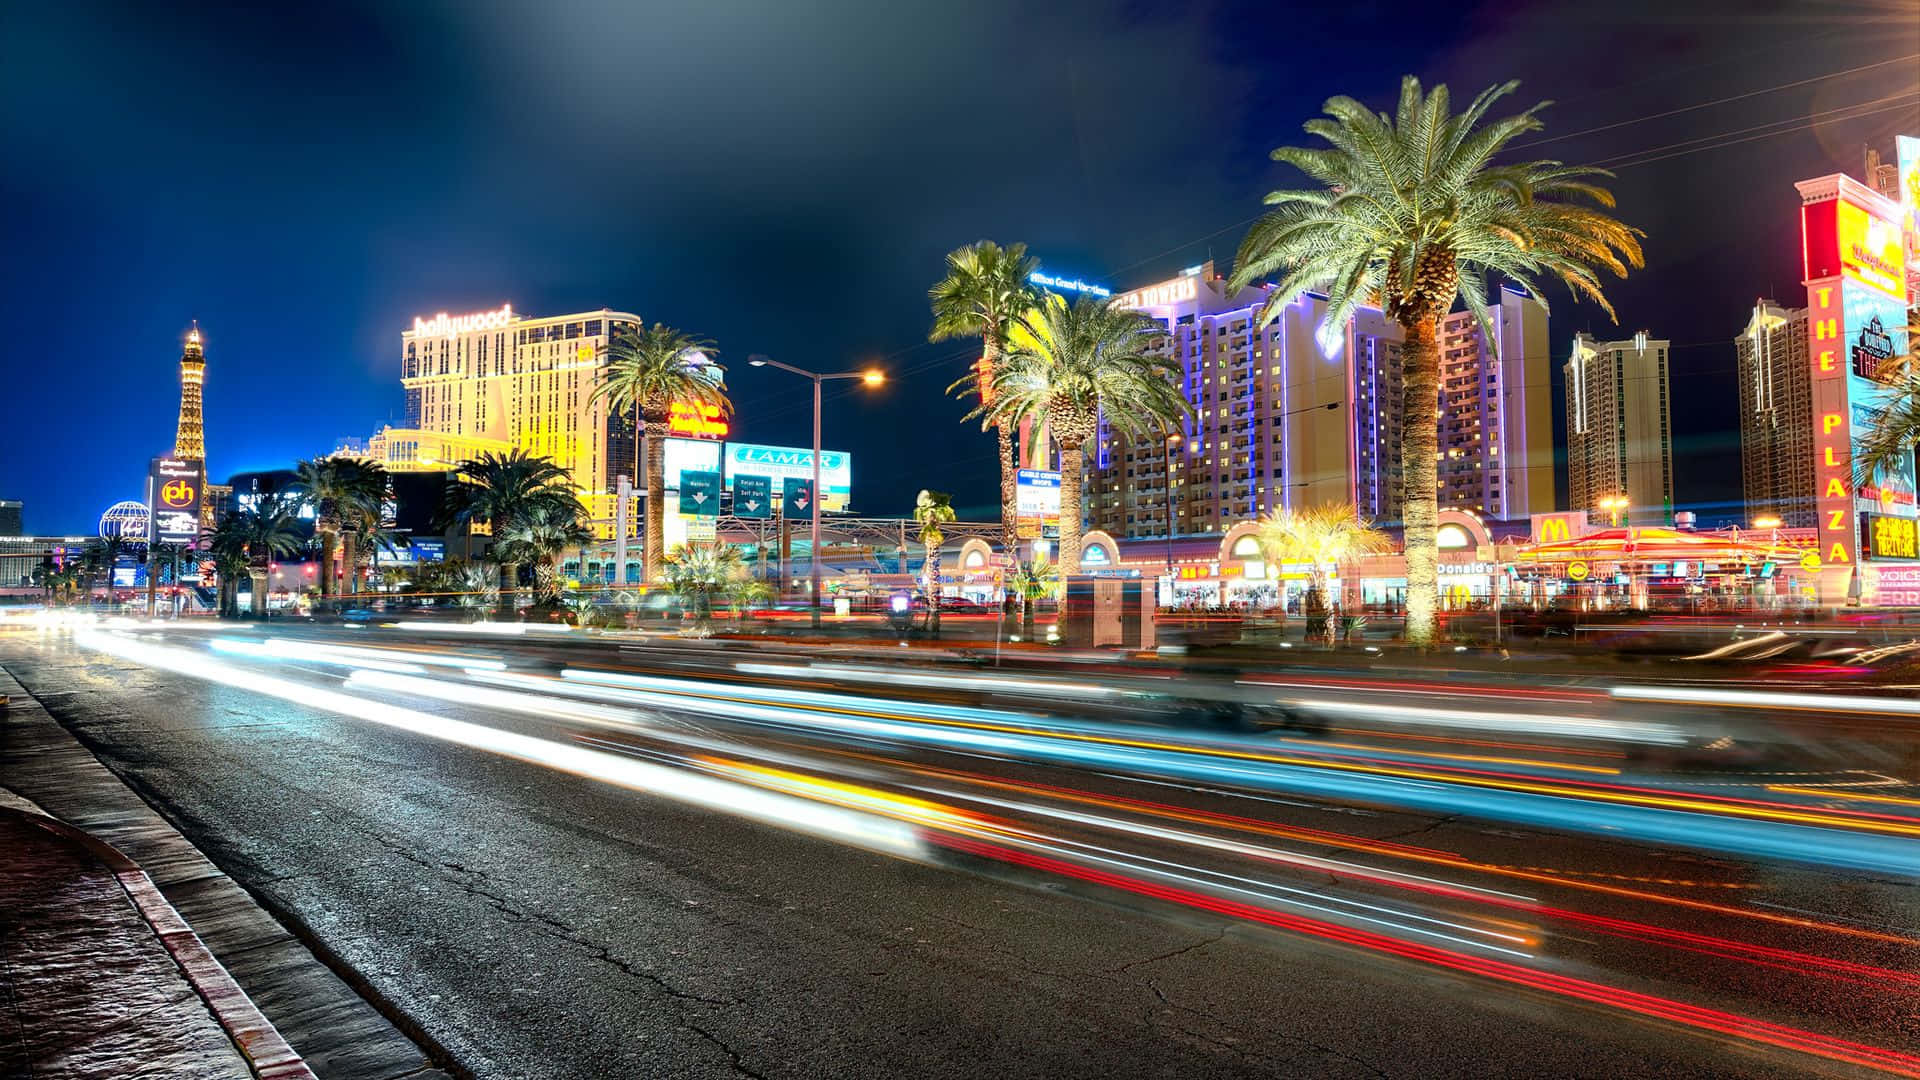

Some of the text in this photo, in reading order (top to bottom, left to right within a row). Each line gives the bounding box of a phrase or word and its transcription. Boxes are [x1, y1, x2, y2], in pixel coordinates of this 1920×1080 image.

[1030, 272, 1110, 297] Hilton Grand Vacations
[1142, 277, 1195, 305] TOWERS
[414, 303, 512, 341] hollywood
[1816, 287, 1849, 562] THE PLAZA
[744, 449, 832, 467] LAMAR
[164, 480, 193, 503] ph
[1437, 562, 1494, 574] Donald's
